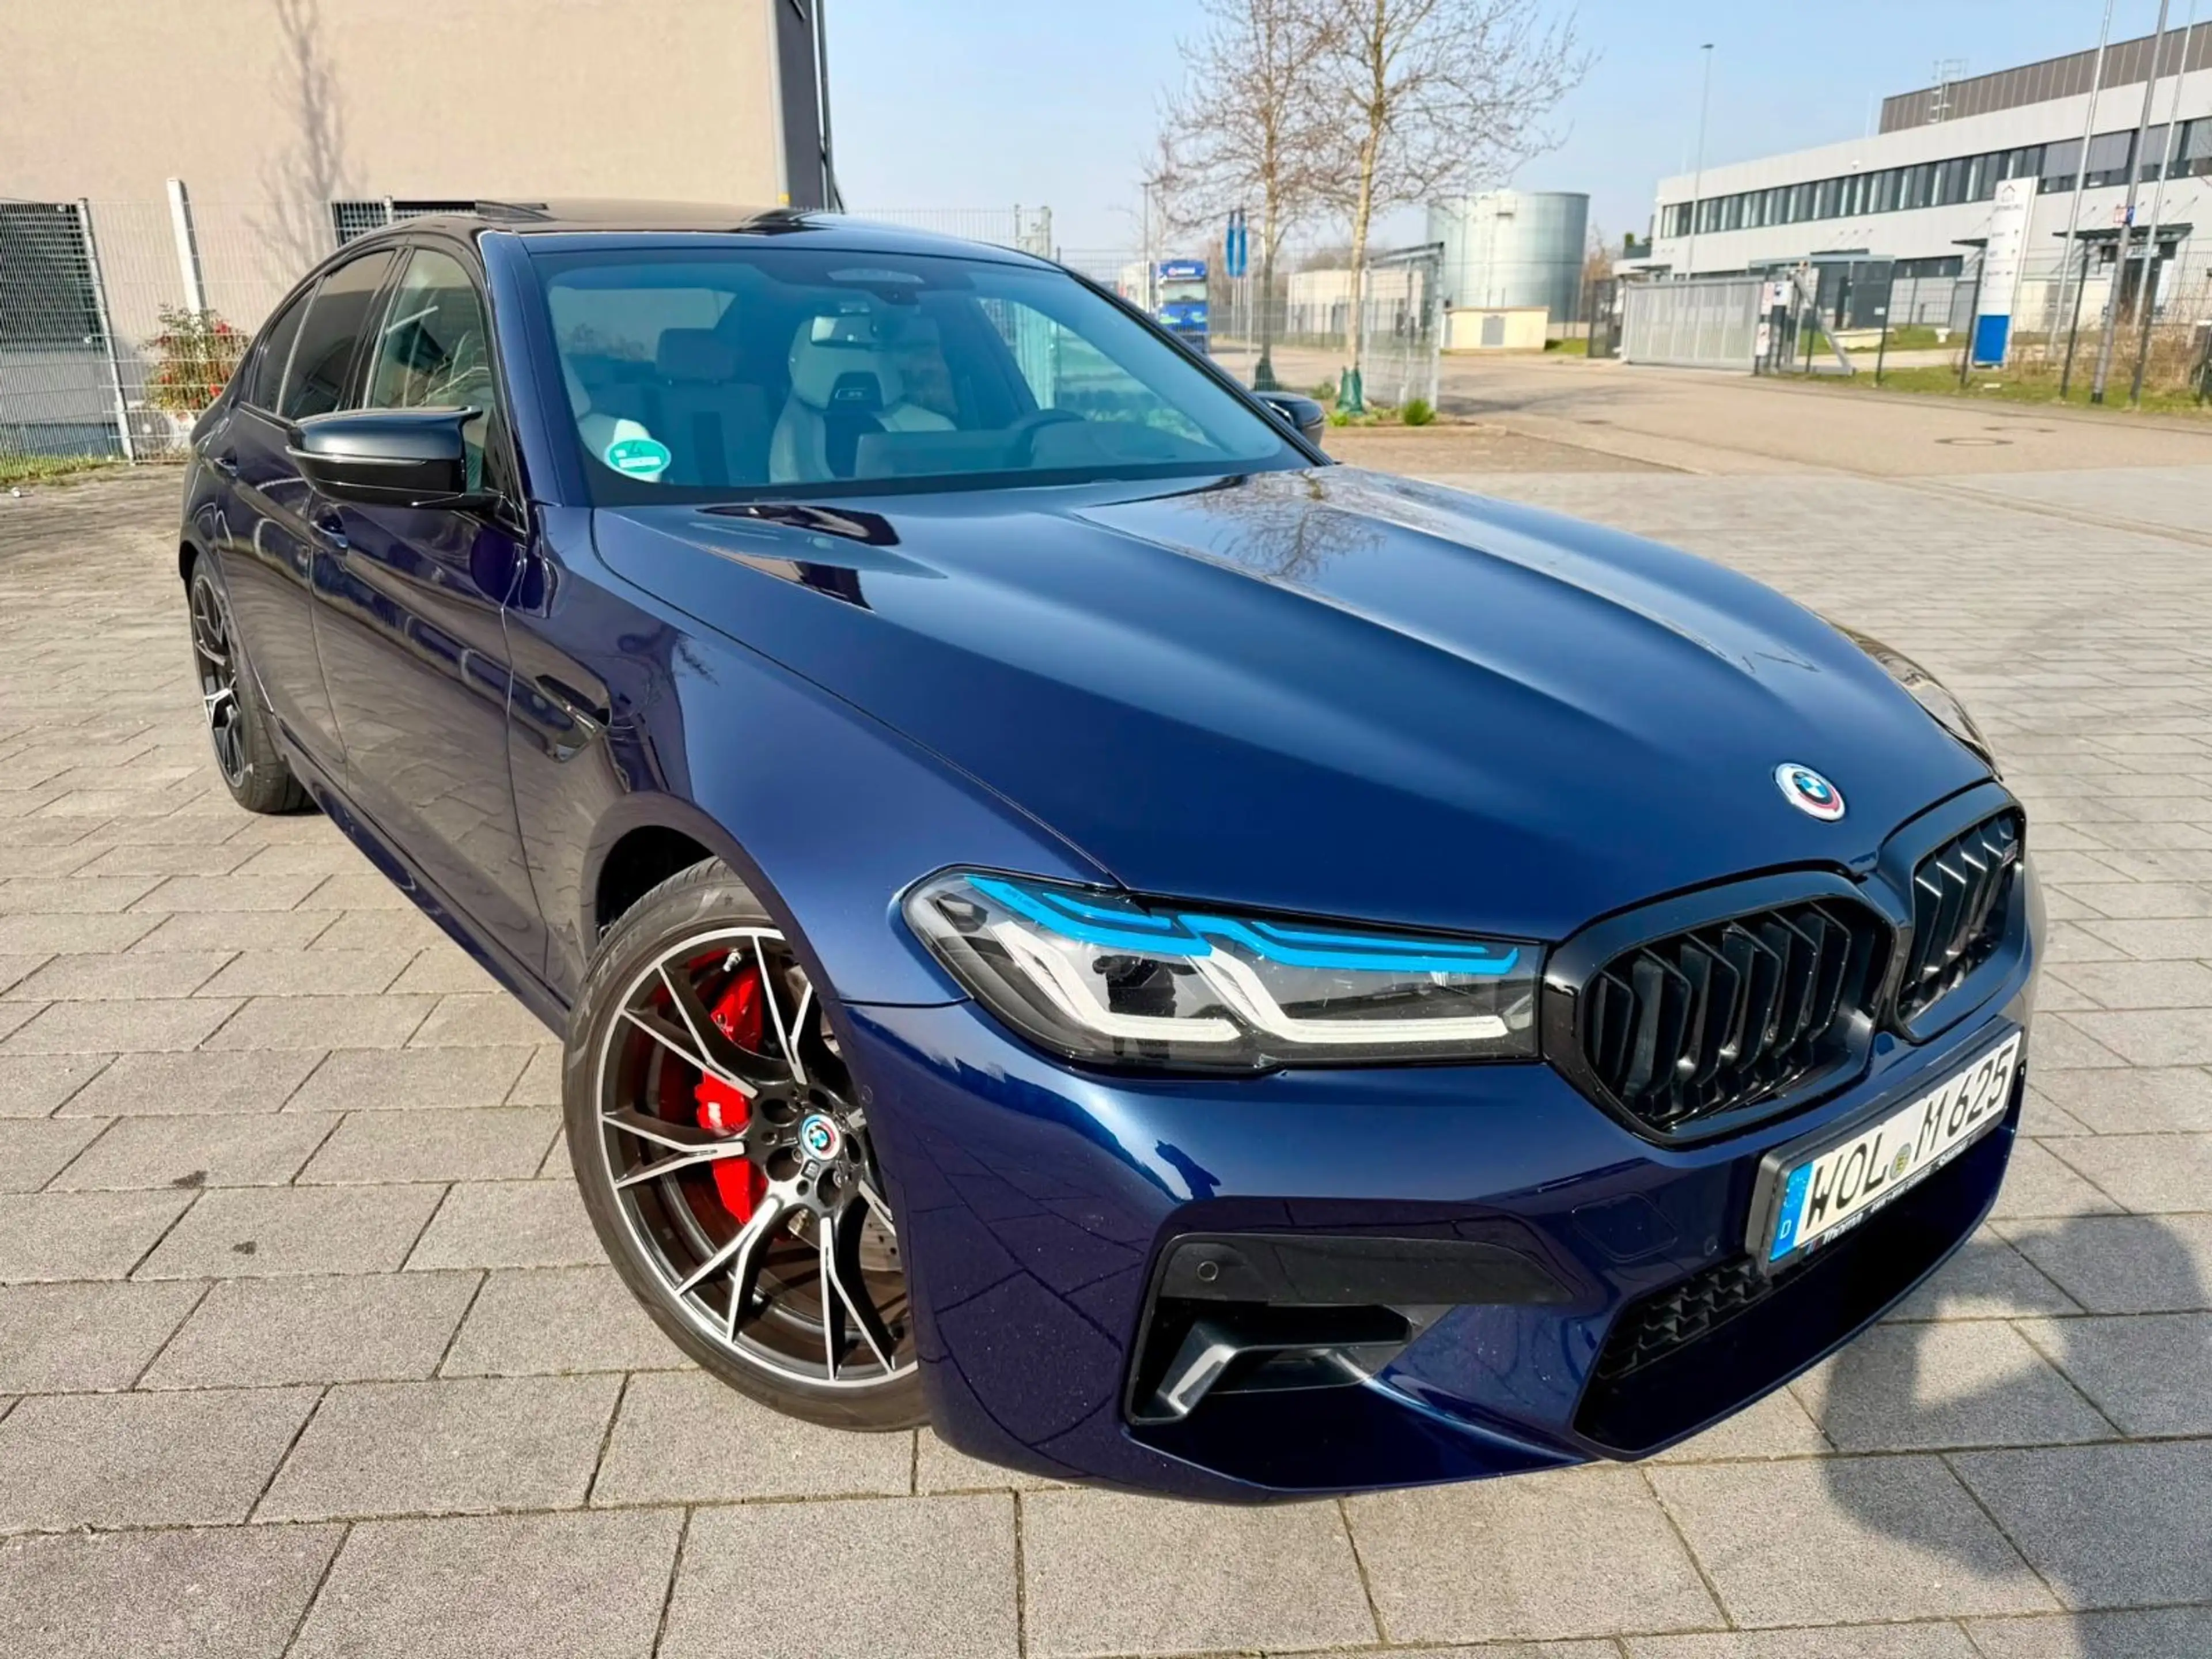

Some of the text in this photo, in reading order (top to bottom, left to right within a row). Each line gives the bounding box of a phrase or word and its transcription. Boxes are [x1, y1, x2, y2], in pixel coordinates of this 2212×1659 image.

[1806, 1132, 1888, 1230] WOL
[1914, 1089, 1949, 1163] M
[1946, 1044, 2015, 1138] 625
[1779, 1218, 1792, 1240] D
